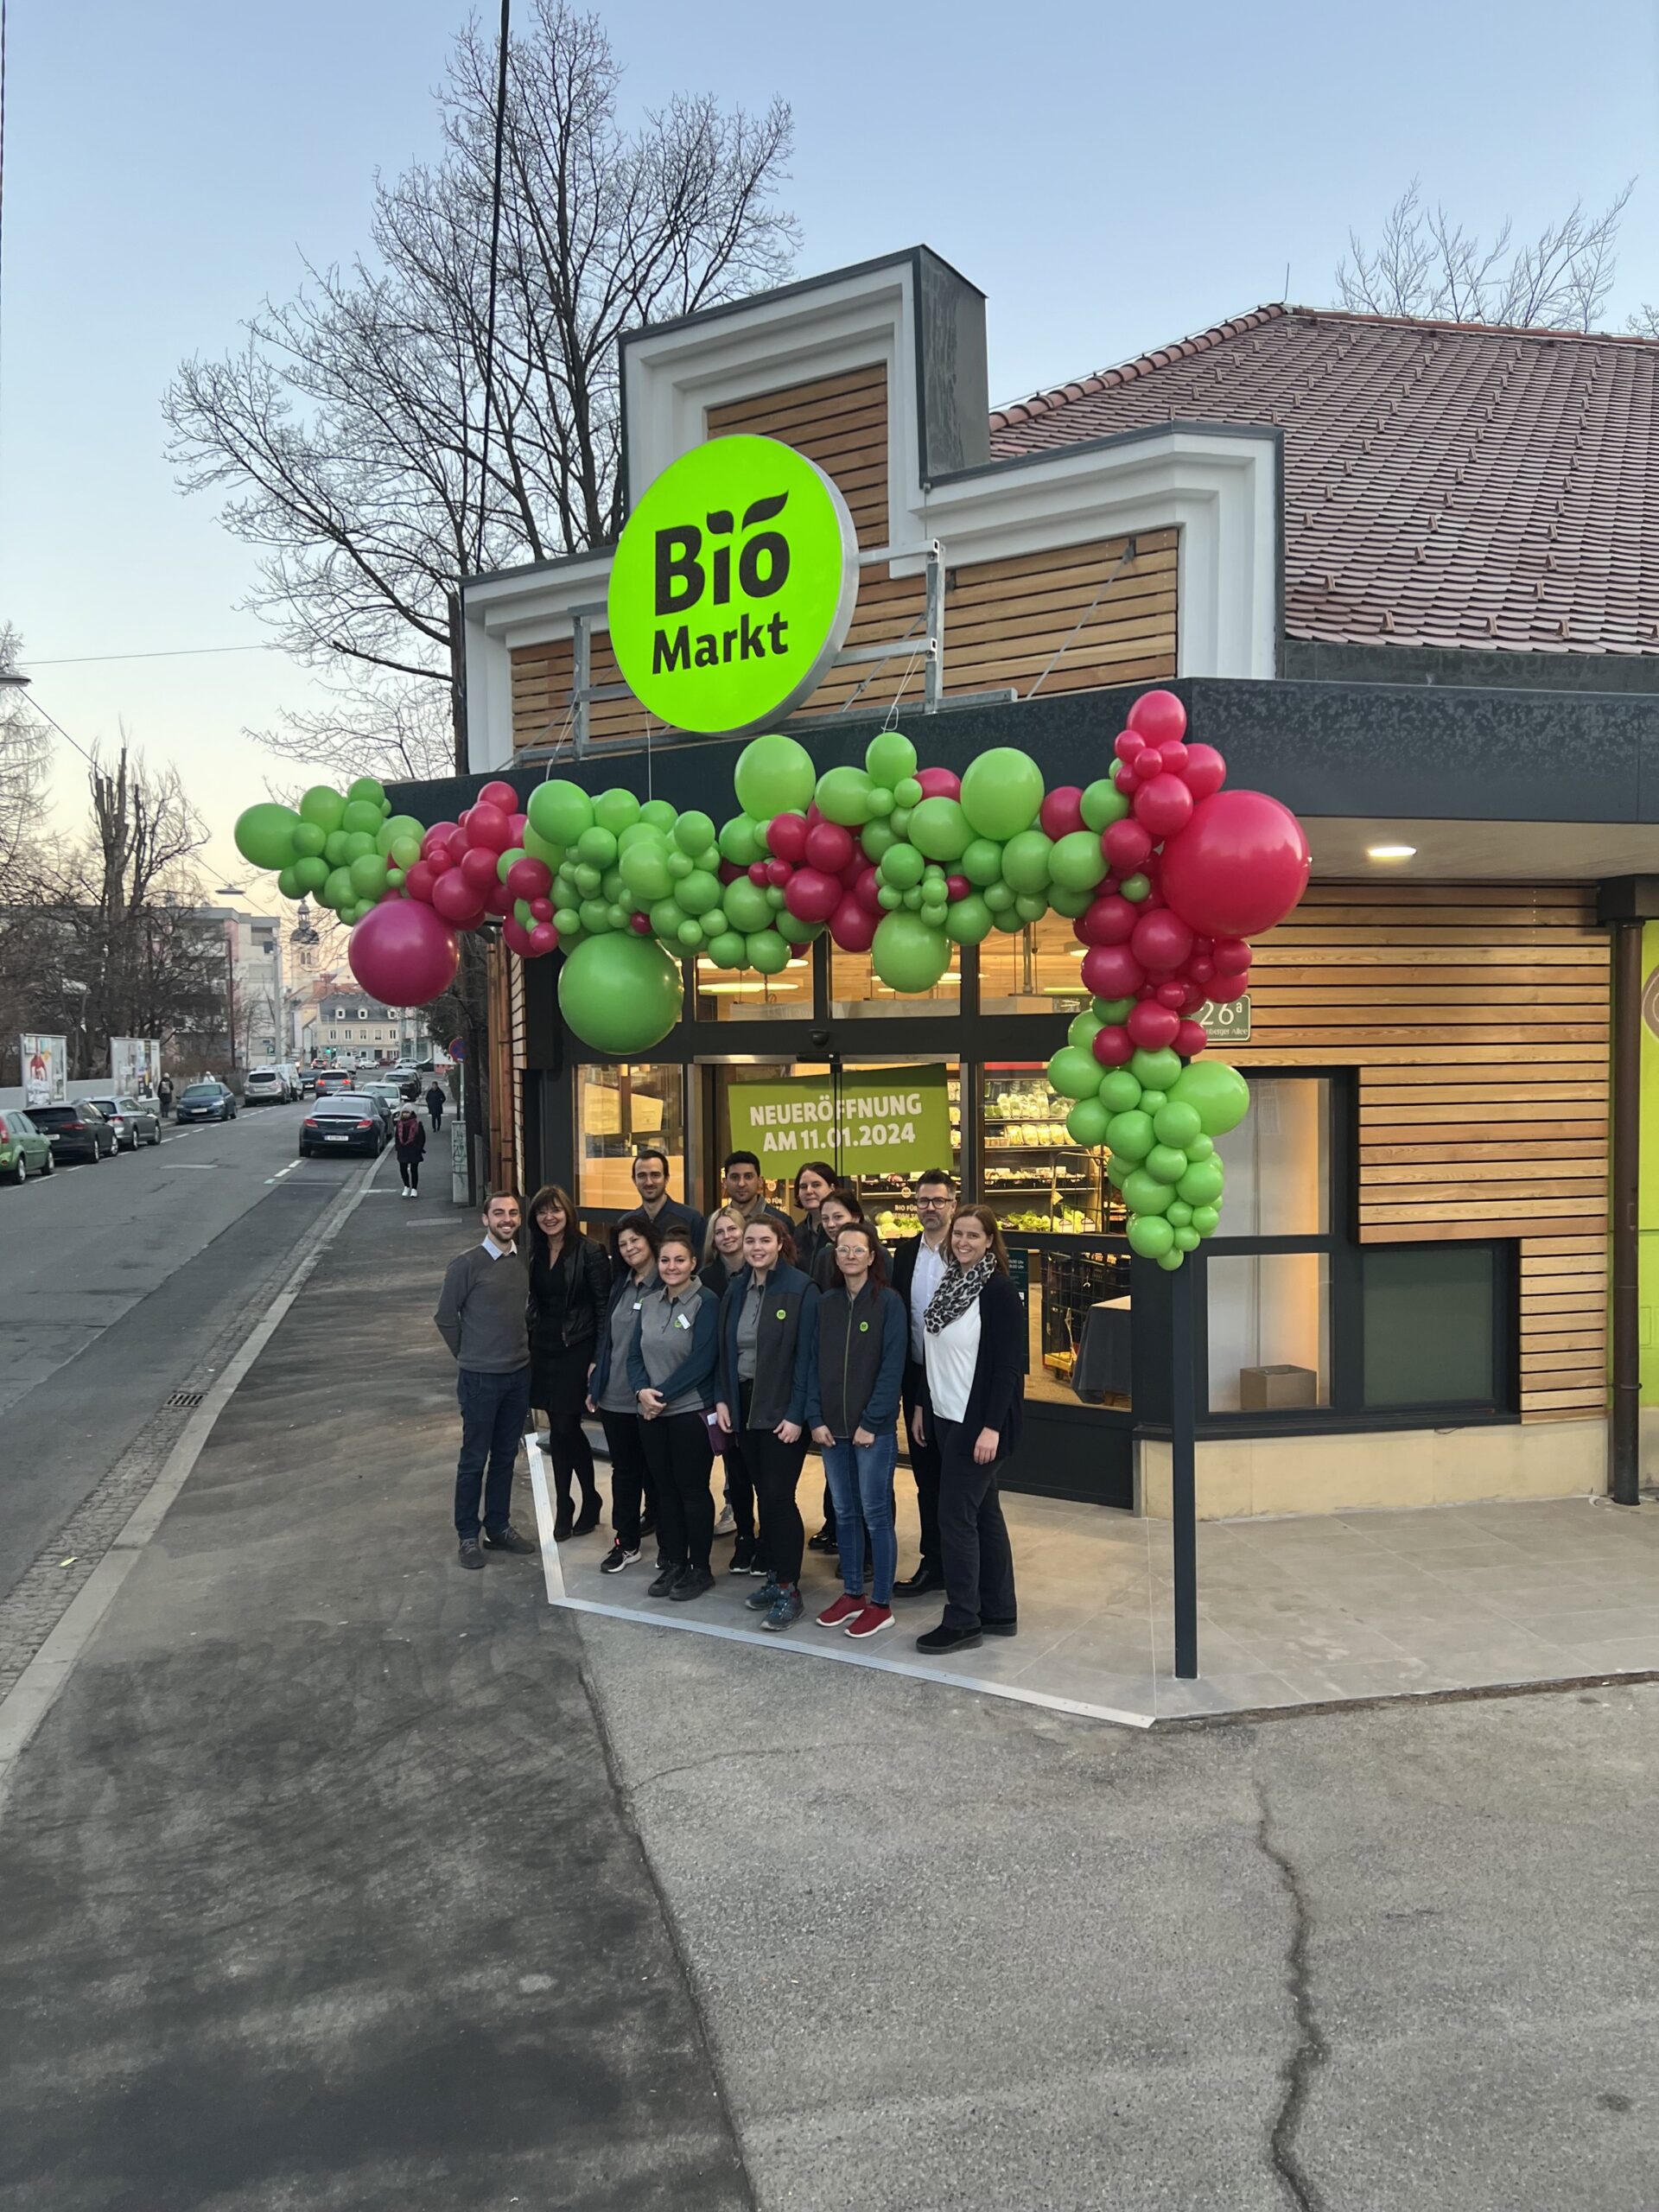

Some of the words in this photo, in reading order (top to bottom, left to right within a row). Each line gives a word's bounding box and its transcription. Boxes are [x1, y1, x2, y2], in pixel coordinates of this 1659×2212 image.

[655, 510, 791, 617] Bio
[652, 611, 788, 675] Markt
[749, 1093, 922, 1127] NEUERÖFFNUNG
[763, 1130, 798, 1152] AM
[800, 1122, 916, 1150] 11.01.2024
